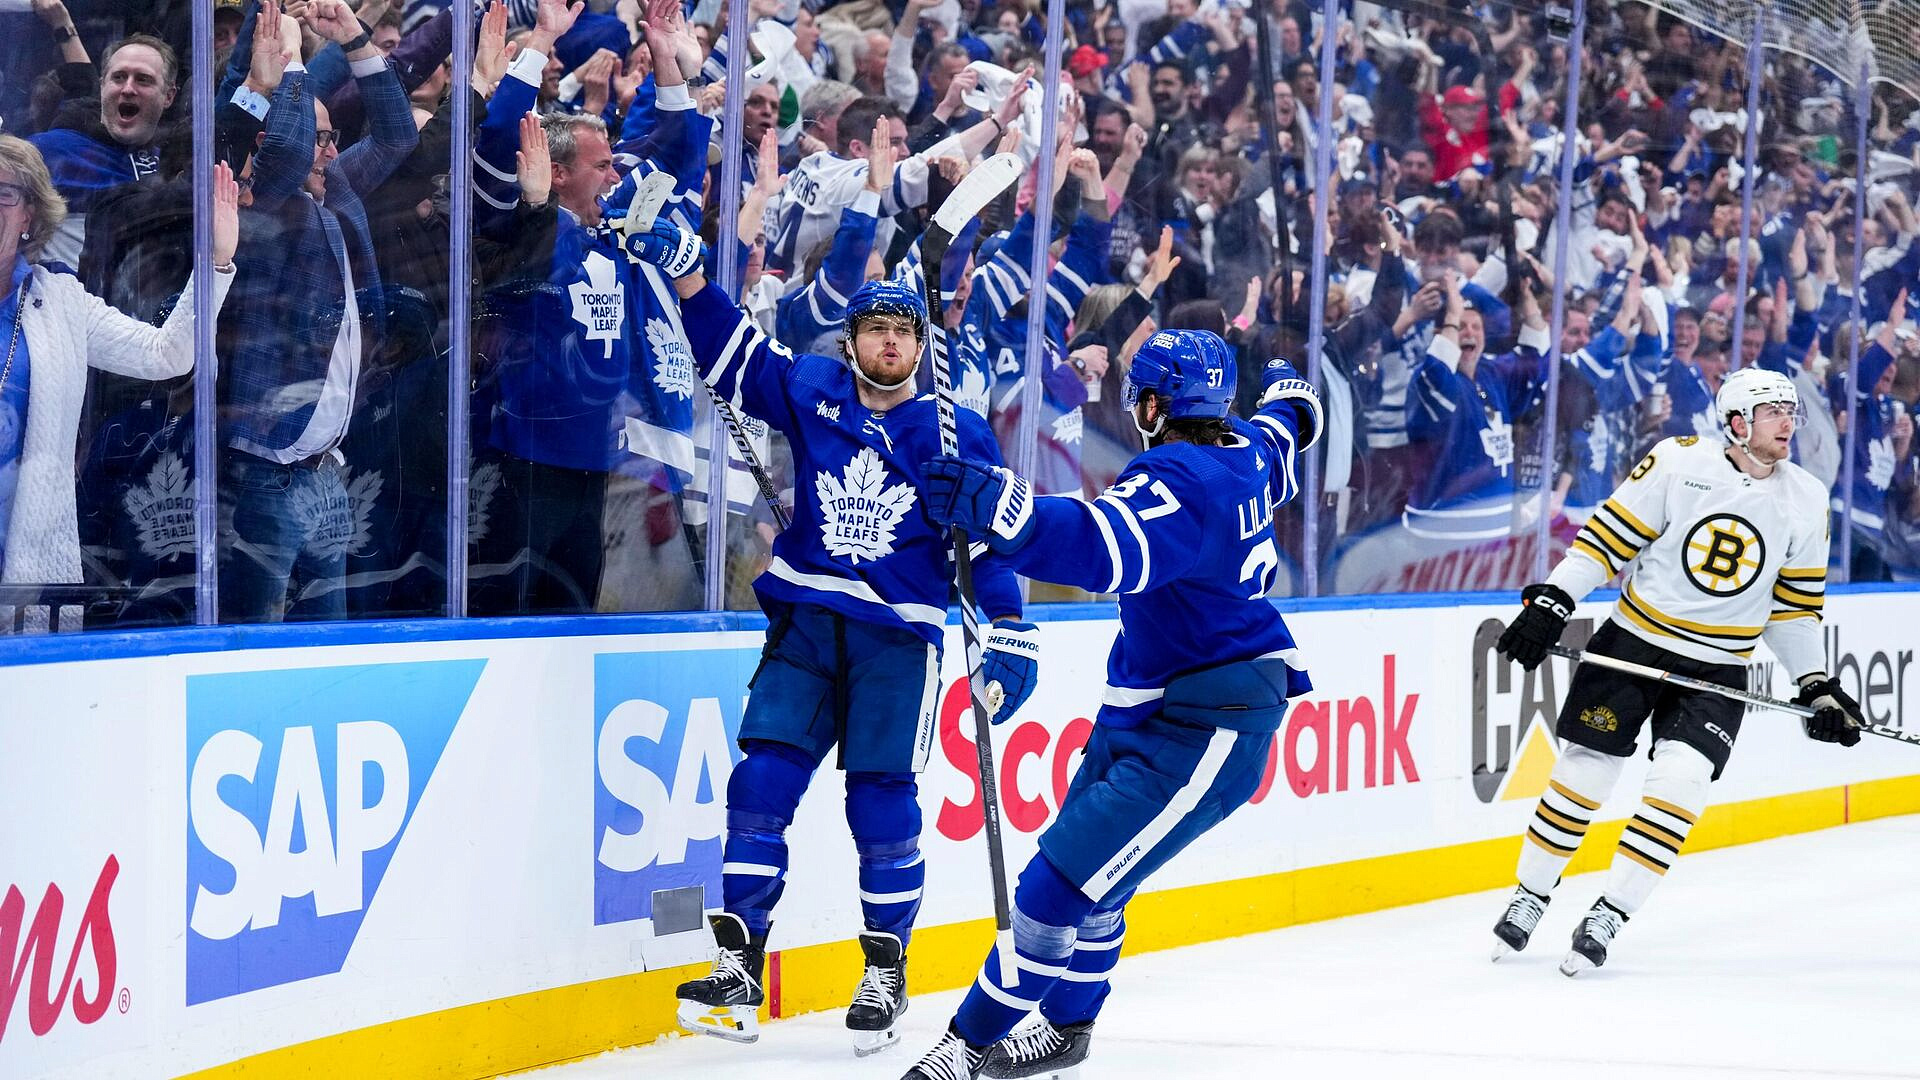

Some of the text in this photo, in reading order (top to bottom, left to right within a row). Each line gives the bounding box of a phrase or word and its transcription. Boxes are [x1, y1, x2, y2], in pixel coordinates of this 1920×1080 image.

[581, 293, 621, 306] TORONTO
[590, 306, 618, 319] MAPLE
[594, 319, 617, 331] LEAFS
[666, 367, 692, 383] LEAFS
[1206, 368, 1224, 388] 37
[816, 400, 841, 422] Milk
[828, 496, 894, 521] TORONTO
[837, 512, 881, 530] MAPLE
[835, 525, 879, 542] LEAFS
[1700, 529, 1745, 579] B
[980, 741, 998, 803] ALPHA
[190, 719, 410, 940] SAP
